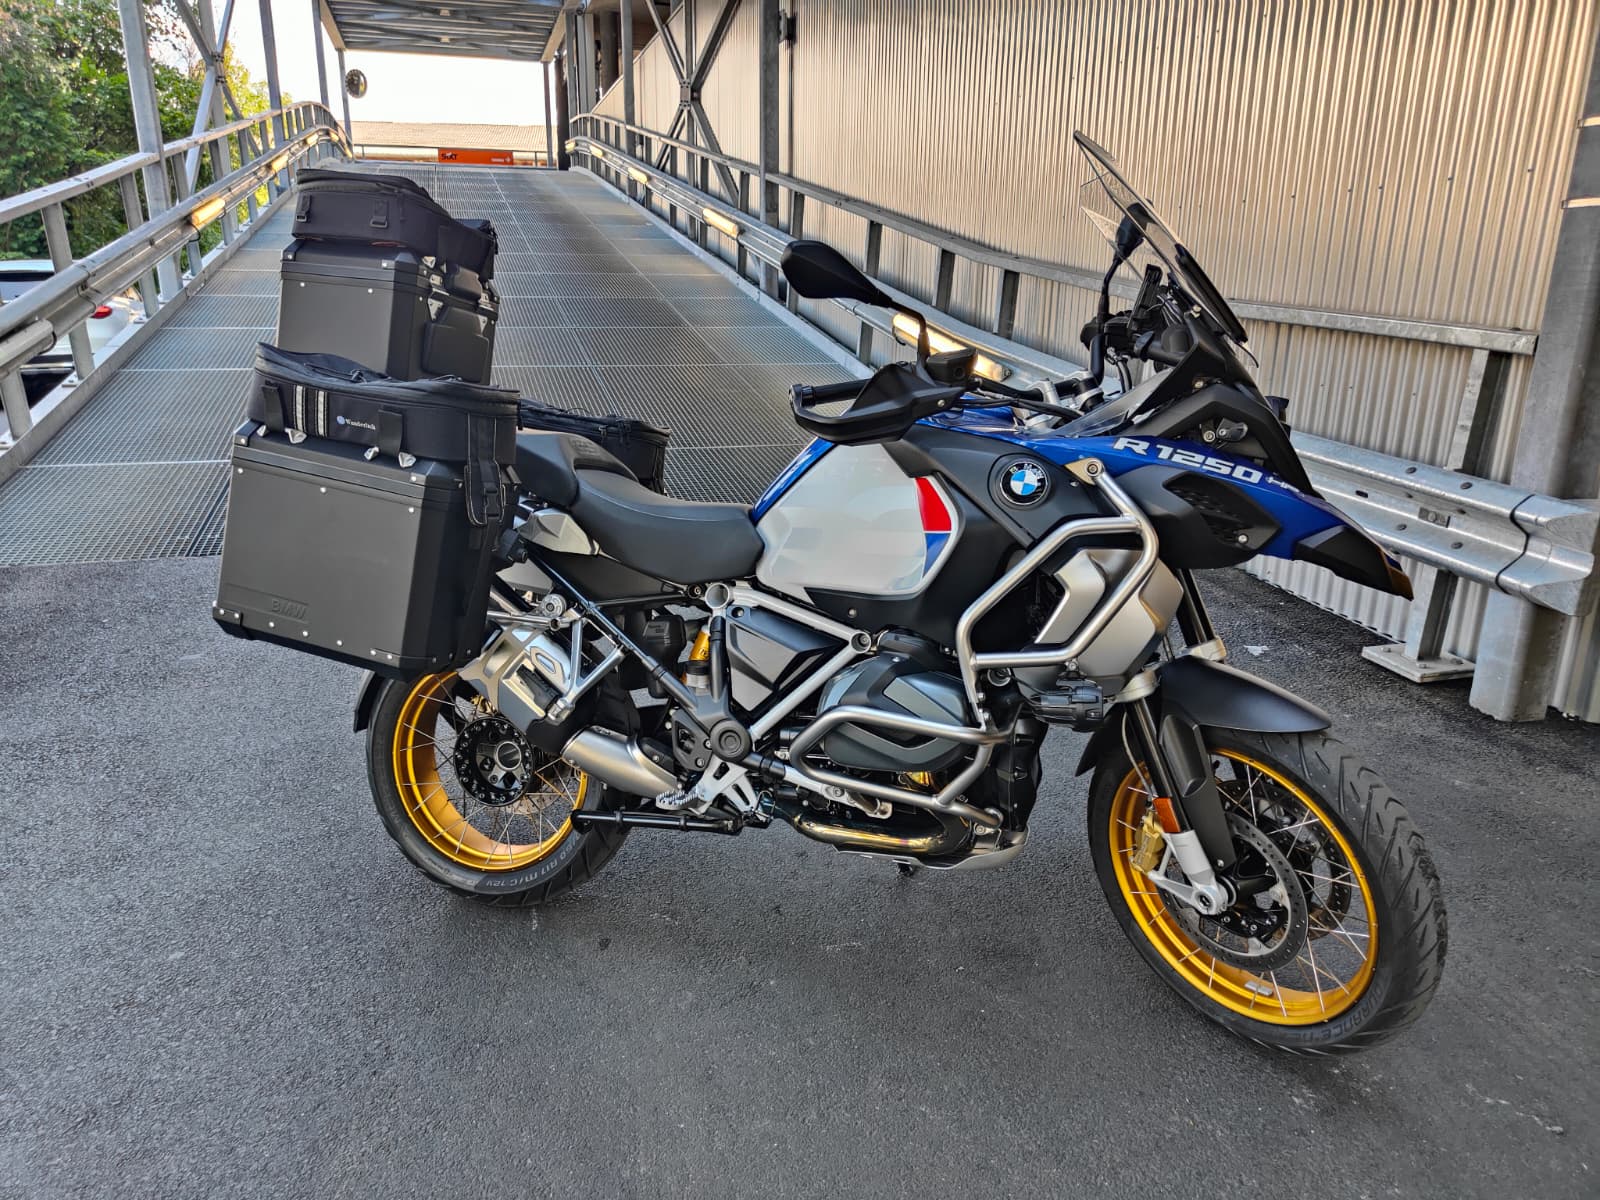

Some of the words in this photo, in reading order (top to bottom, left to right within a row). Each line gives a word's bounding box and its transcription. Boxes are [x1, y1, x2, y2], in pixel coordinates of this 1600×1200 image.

[1113, 437, 1150, 456] R
[1156, 444, 1263, 484] 1250
[271, 598, 308, 620] BMW
